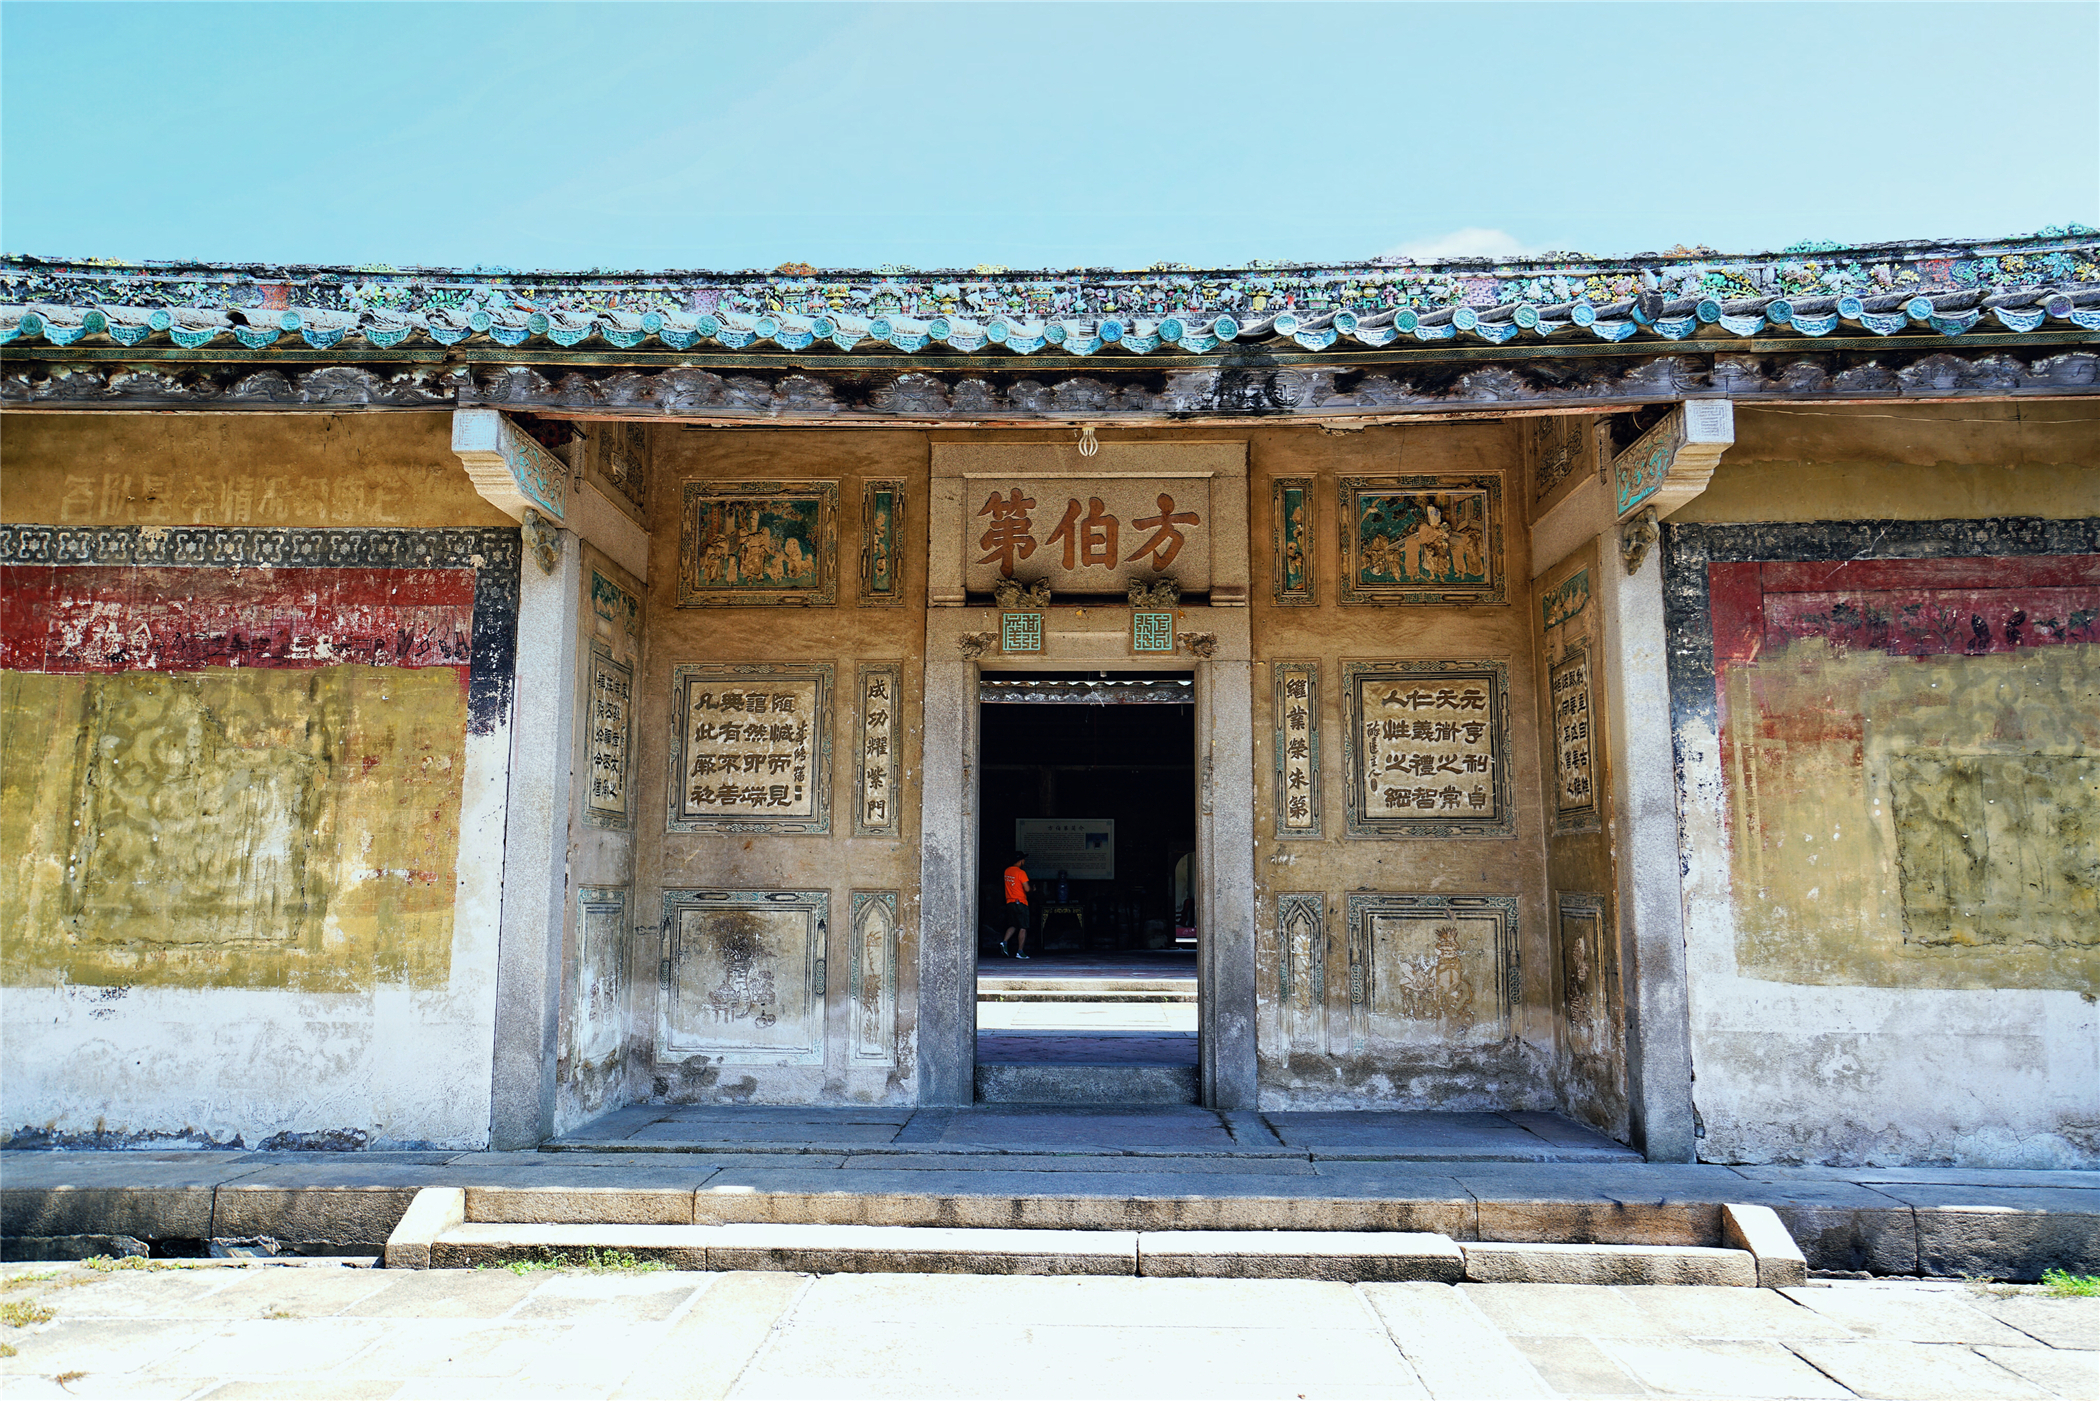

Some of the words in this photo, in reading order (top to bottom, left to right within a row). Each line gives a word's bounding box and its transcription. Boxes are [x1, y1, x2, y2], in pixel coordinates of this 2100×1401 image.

[975, 488, 1201, 578] 方伯第
[866, 679, 889, 820] 成功耀紫門
